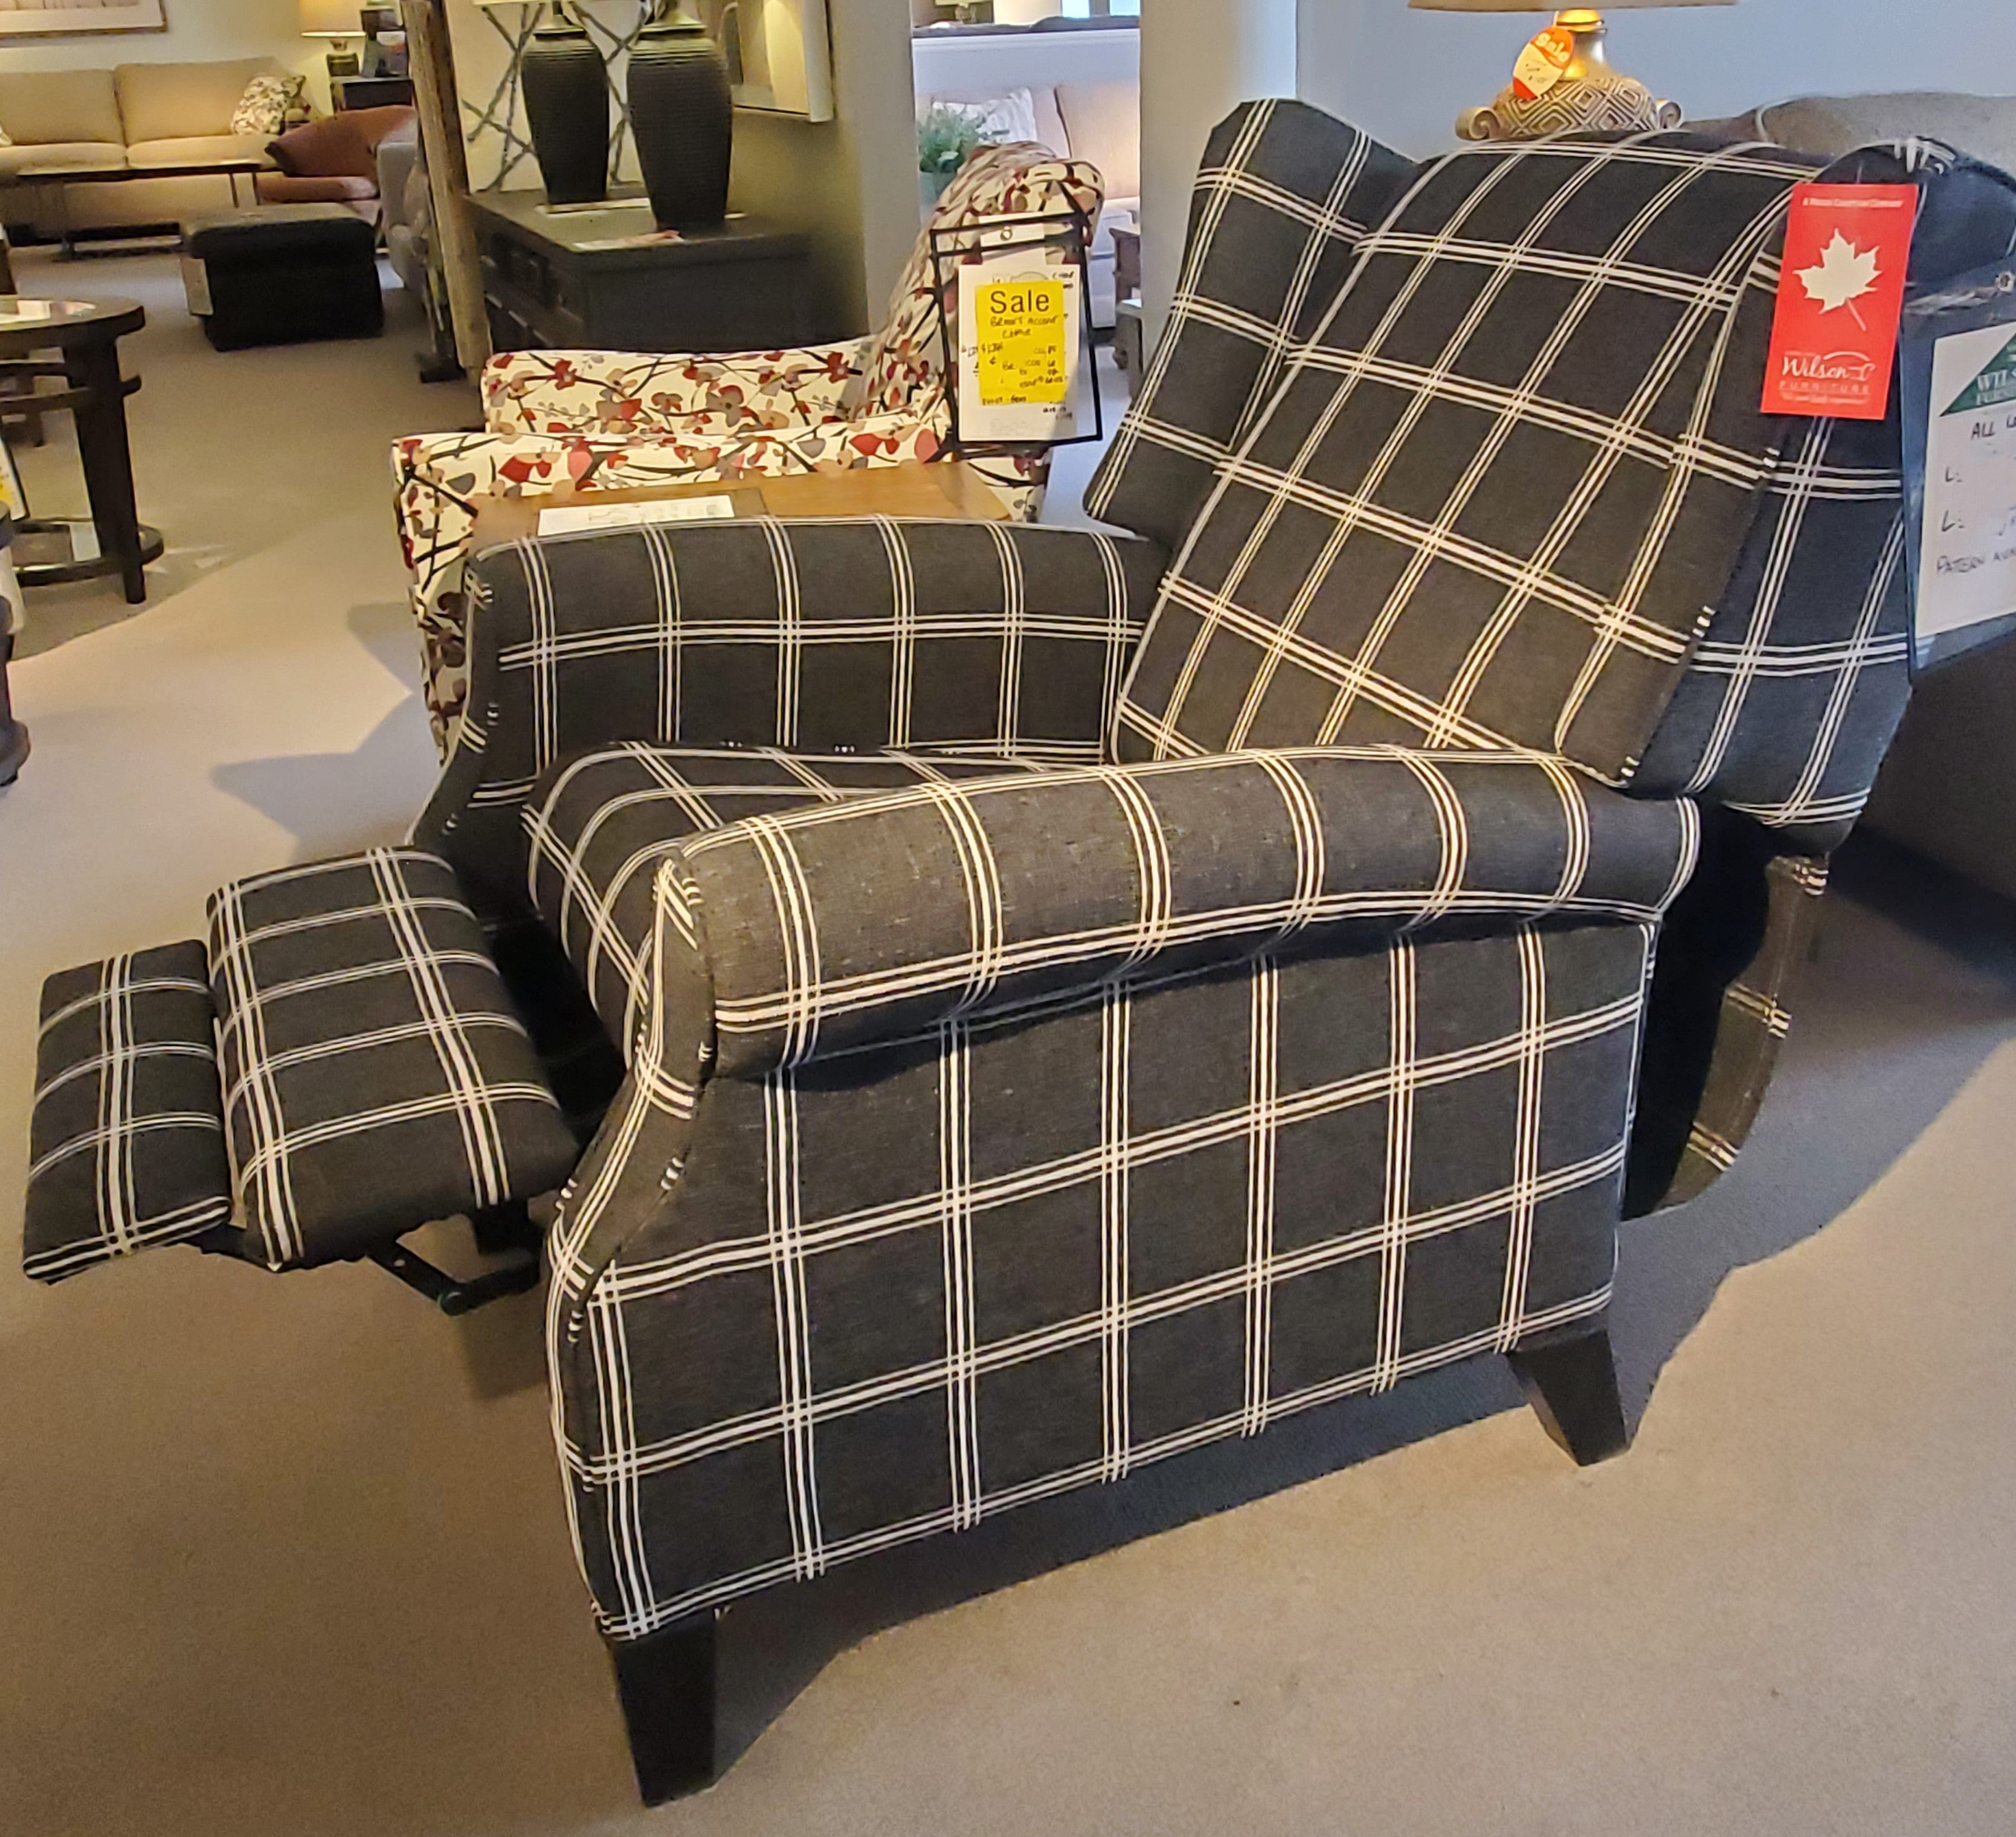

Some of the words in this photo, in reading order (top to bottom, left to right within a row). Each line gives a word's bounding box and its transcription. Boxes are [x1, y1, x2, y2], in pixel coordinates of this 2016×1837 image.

[1535, 32, 1571, 63] Sale
[990, 289, 1050, 314] Sale
[1782, 354, 1849, 379] Wilson
[1970, 421, 1996, 441] ALL
